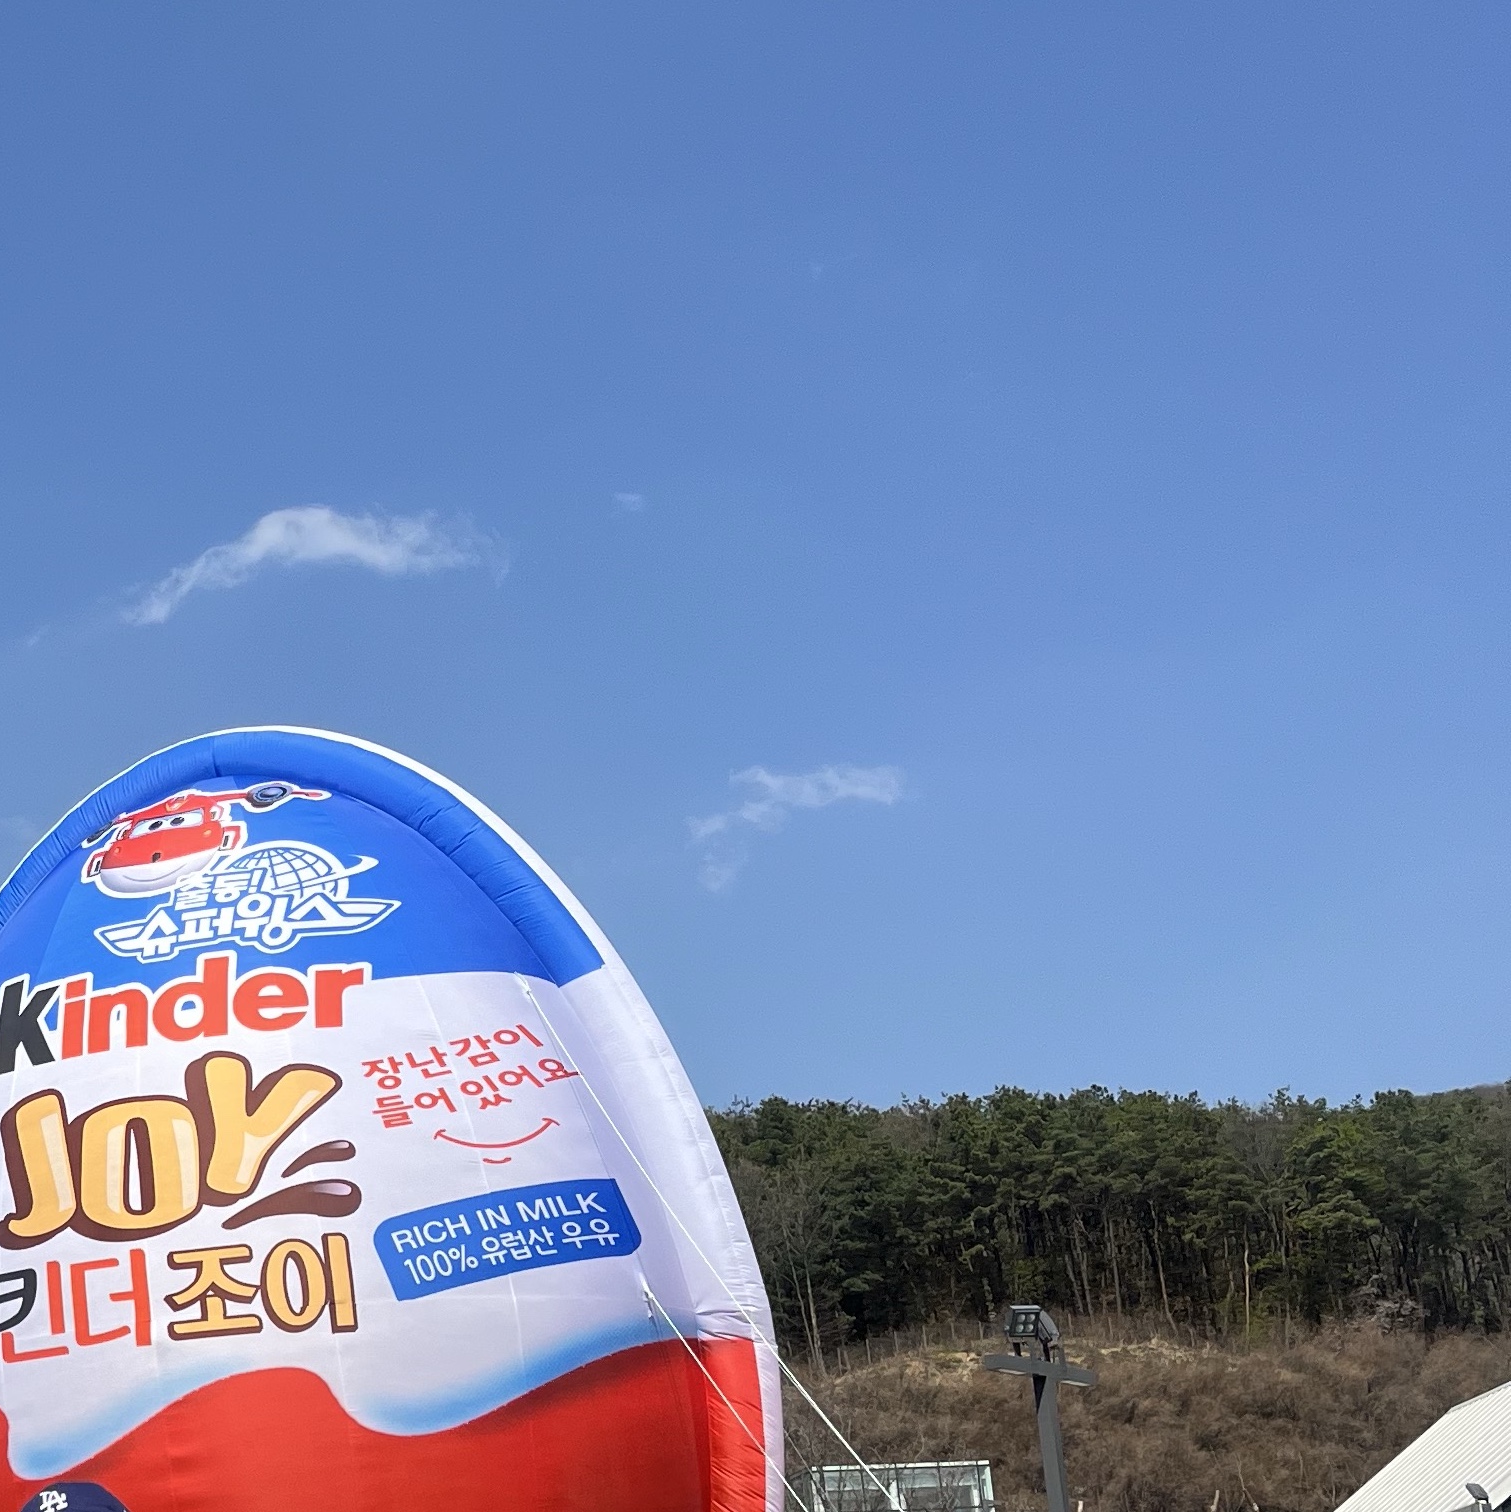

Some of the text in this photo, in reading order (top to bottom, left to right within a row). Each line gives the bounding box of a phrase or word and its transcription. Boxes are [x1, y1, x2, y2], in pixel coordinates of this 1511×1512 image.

[110, 891, 378, 957] 슈퍼윙스
[372, 1058, 580, 1129] 들어 있어요
[391, 1192, 607, 1254] RICH IN MILK
[403, 1218, 620, 1285] 100% 유럽산 우유
[164, 1232, 358, 1341] 조이
